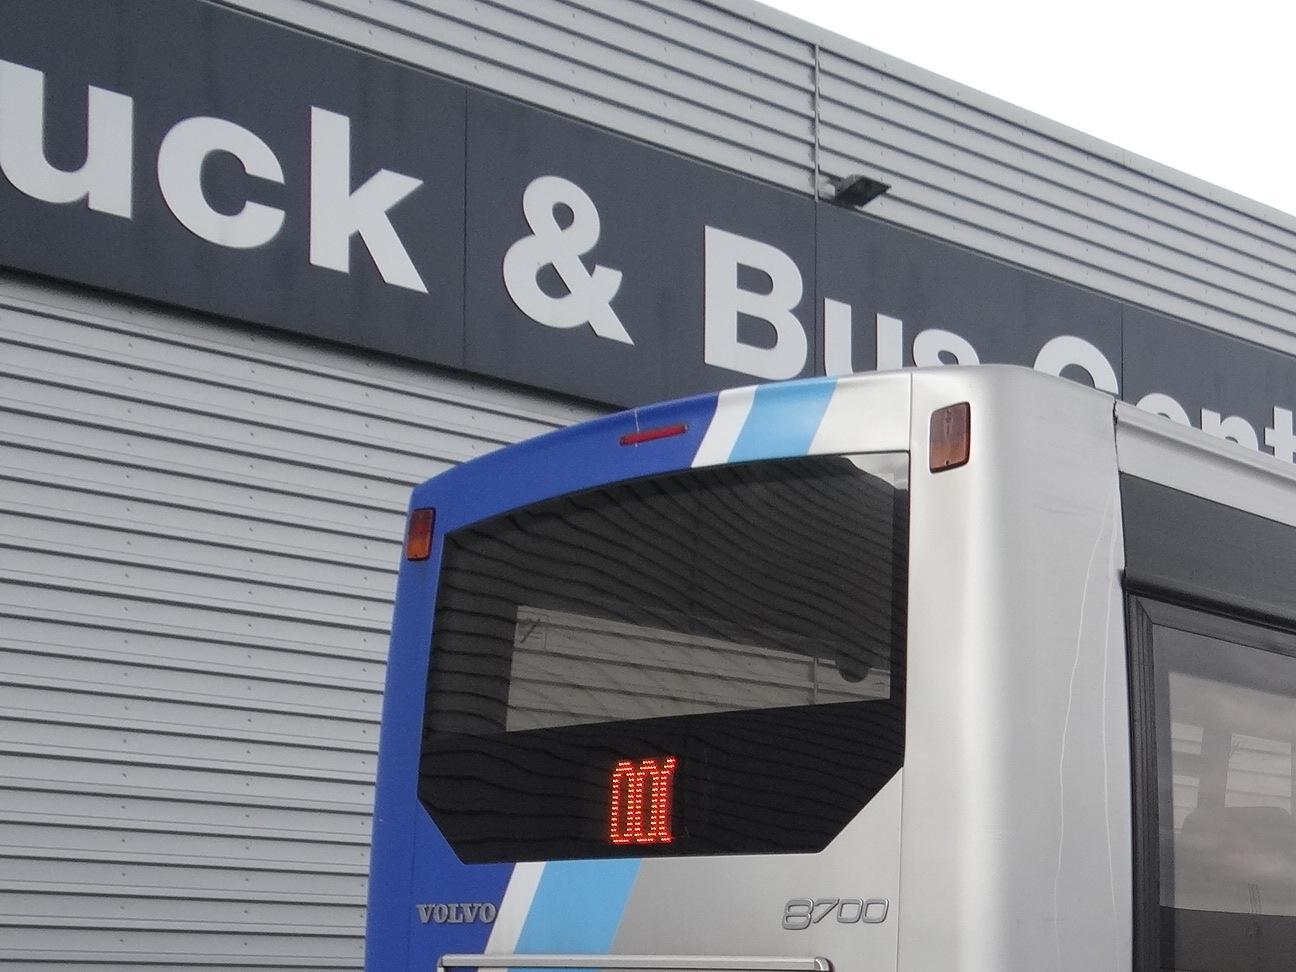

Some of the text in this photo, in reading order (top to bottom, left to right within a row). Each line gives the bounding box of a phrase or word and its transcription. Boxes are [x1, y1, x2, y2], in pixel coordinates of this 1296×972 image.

[503, 175, 635, 346] &
[416, 902, 497, 924] VOLVO
[782, 898, 889, 930] 8700
